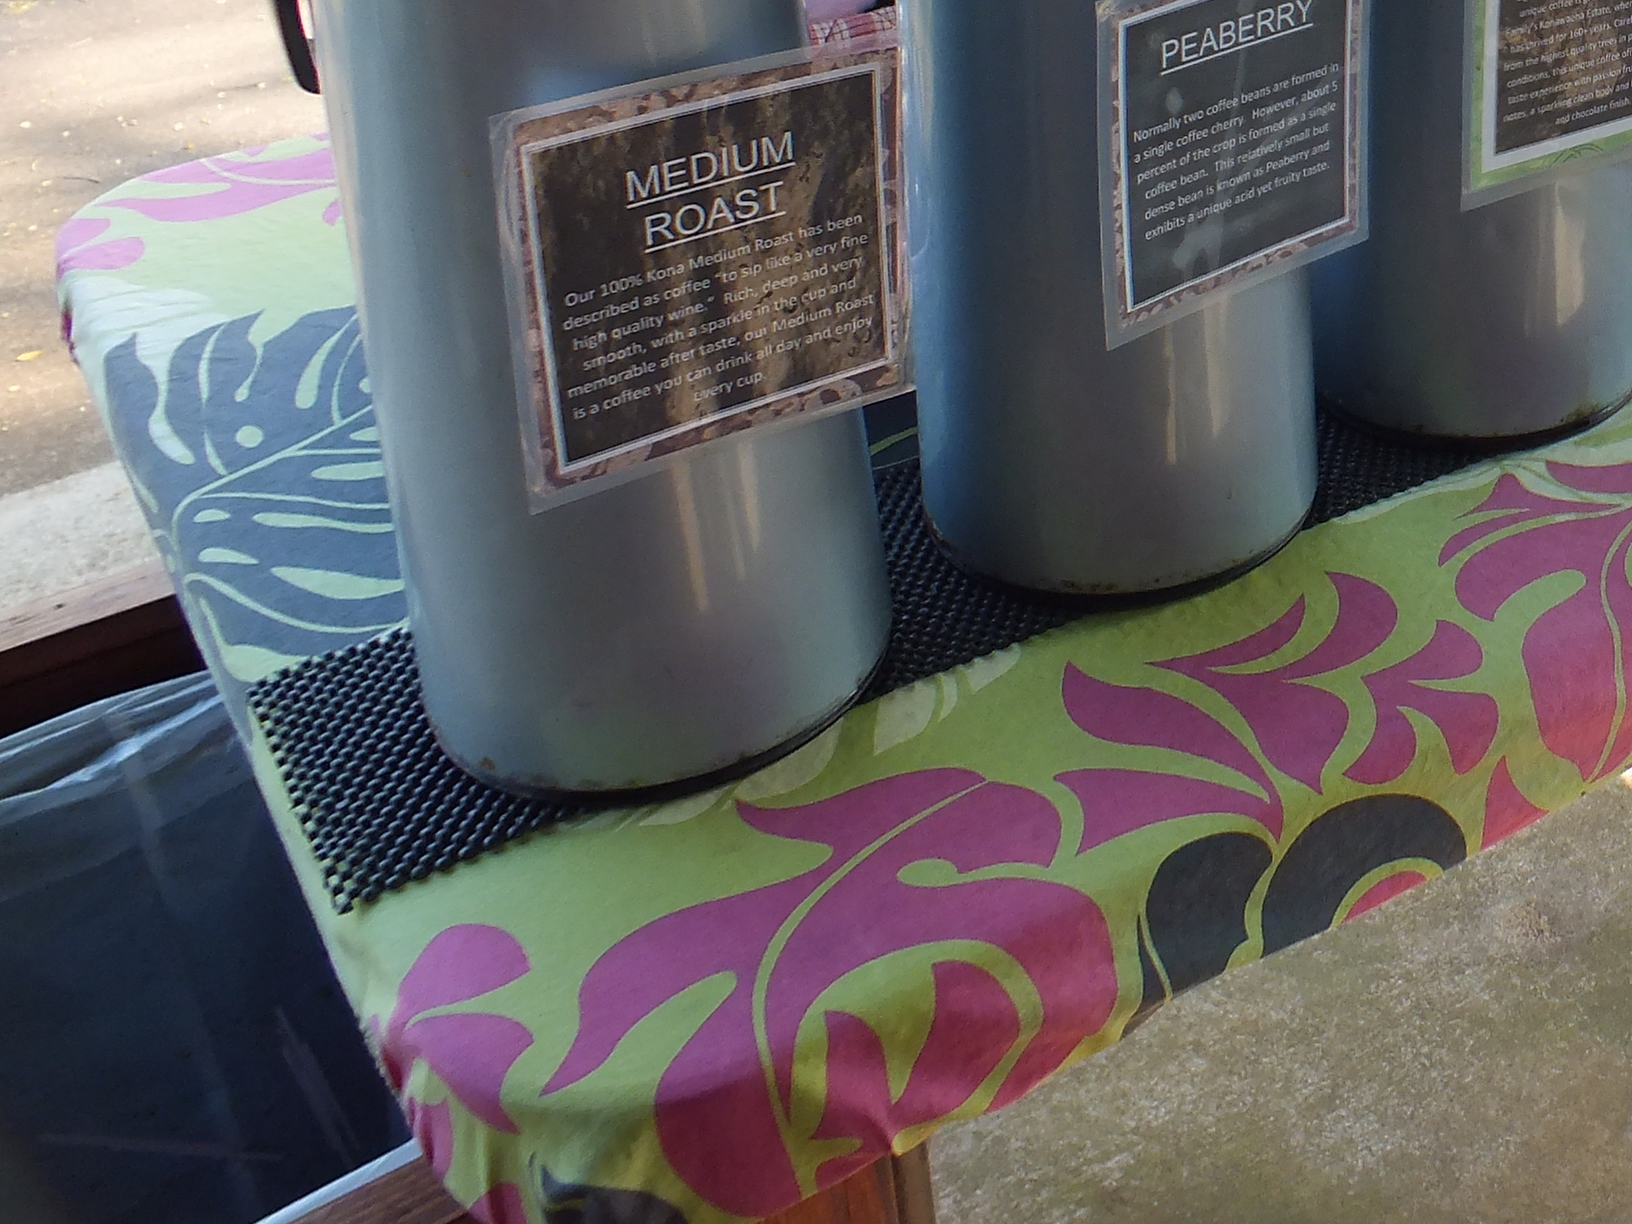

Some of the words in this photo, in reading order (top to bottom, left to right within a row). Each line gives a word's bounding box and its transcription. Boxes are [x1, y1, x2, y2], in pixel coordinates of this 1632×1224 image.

[1549, 0, 1573, 10] coffee
[1134, 118, 1181, 142] Normally
[1184, 111, 1204, 124] two
[1206, 99, 1238, 116] coffee
[1241, 87, 1271, 104] beans
[1273, 81, 1289, 93] are
[1292, 65, 1327, 86] formed
[1331, 64, 1338, 72] in
[1134, 155, 1140, 163] a
[1144, 141, 1173, 160] single
[1176, 129, 1208, 147] coffee
[1302, 85, 1329, 102] about
[1332, 81, 1338, 91] 5
[1572, 105, 1607, 120] chocolate
[625, 132, 795, 202] MEDIUM
[1137, 159, 1177, 185] percent
[1179, 153, 1190, 166] of
[1192, 148, 1210, 161] the
[1213, 139, 1236, 153] crop
[1239, 135, 1246, 144] is
[1249, 119, 1284, 140] formed
[1288, 117, 1298, 126] as
[1301, 114, 1306, 122] a
[1308, 102, 1336, 119] single
[1145, 181, 1177, 199] coffee
[1215, 159, 1234, 172] This
[1237, 140, 1283, 164] relatively
[1284, 128, 1310, 146] small
[1313, 122, 1329, 136] but
[1145, 202, 1175, 220] dense
[1178, 191, 1204, 207] bean
[1206, 187, 1214, 196] is
[1216, 173, 1251, 192] known
[1266, 150, 1309, 173] Peaberry
[1312, 140, 1329, 155] and
[645, 182, 785, 246] ROAST
[1145, 218, 1185, 240] exhibits
[1188, 214, 1194, 223] a
[1197, 199, 1232, 219] unique
[1235, 188, 1254, 204] acid
[1257, 182, 1272, 198] yet
[1275, 173, 1301, 188] fruity
[563, 296, 639, 331] described
[643, 294, 660, 306] as
[664, 279, 711, 300] coffee
[743, 264, 762, 278] sip
[766, 255, 791, 271] like
[795, 253, 802, 262] a
[806, 243, 838, 259] very
[841, 234, 868, 249] fine
[564, 290, 596, 307] Our
[600, 273, 643, 296] 100%
[646, 264, 685, 283] Kona
[689, 245, 750, 270] Medium
[756, 231, 794, 251] Roast
[799, 225, 823, 239] has
[828, 214, 862, 231] been
[573, 329, 607, 350] high
[612, 315, 665, 342] quality
[725, 284, 758, 304] Rich,
[763, 275, 798, 293] deep
[802, 263, 828, 282] and
[833, 256, 864, 273] very
[583, 340, 647, 371] smooth,
[652, 327, 684, 348] with
[688, 327, 697, 337] a
[701, 309, 752, 334] sparkle
[758, 305, 770, 316] in
[774, 296, 797, 311] the
[802, 288, 827, 303] cup
[831, 276, 855, 294] and
[567, 361, 657, 398] memorable
[660, 349, 695, 368] after
[699, 337, 740, 356] taste,
[745, 328, 766, 342] our
[773, 308, 832, 333] Medium
[836, 293, 873, 313] Roast
[573, 408, 586, 420] is
[589, 404, 600, 415] a
[603, 386, 651, 410] coffee
[655, 376, 682, 396] you
[687, 367, 711, 382] can
[716, 350, 752, 373] drink
[756, 344, 772, 360] all
[776, 338, 802, 354] day
[806, 326, 831, 344] and
[835, 316, 873, 335] enjoy
[694, 382, 733, 402] every
